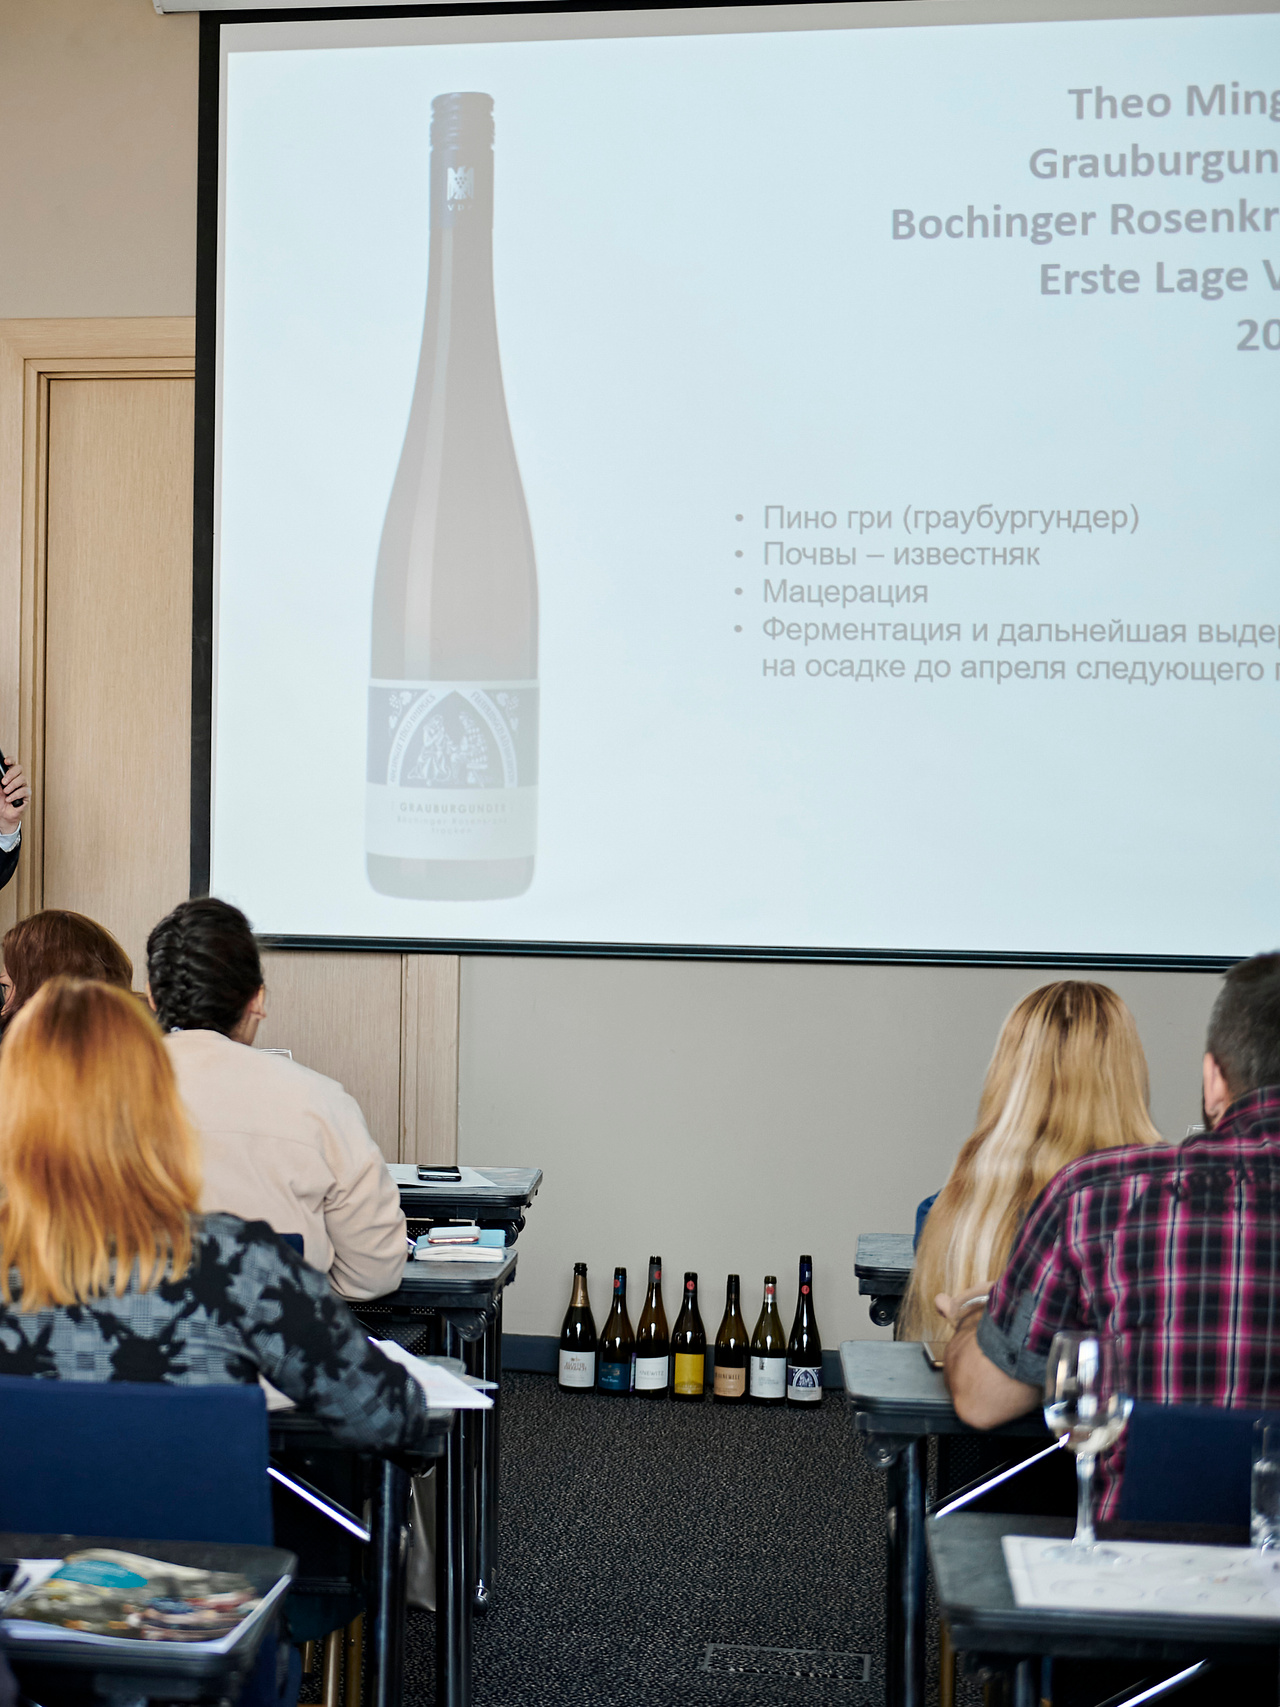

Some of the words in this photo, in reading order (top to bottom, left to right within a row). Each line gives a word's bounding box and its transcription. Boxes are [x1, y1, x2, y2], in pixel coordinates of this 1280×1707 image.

[1067, 85, 1172, 120] Theo
[1029, 143, 1280, 184] Grauburgun
[892, 204, 1097, 245] Bochinger
[1110, 198, 1280, 236] Rosenkr
[1040, 264, 1141, 296] Erste
[1155, 262, 1249, 301] Lage
[1236, 318, 1280, 352] 20
[764, 505, 838, 530] Пино
[847, 510, 893, 535] гри
[902, 504, 1140, 535] (граубургундер)
[764, 541, 857, 566] Почвы
[893, 546, 1041, 566] известняк
[763, 579, 929, 609] Мацерация
[762, 617, 962, 646] Ферментация
[972, 622, 989, 642] и
[997, 618, 1187, 647] дальнейшая
[1198, 623, 1280, 649] выде
[762, 658, 796, 677] на
[805, 658, 906, 683] осадке
[914, 659, 952, 684] до
[960, 659, 1066, 685] апреля
[1076, 660, 1265, 687] следующего
